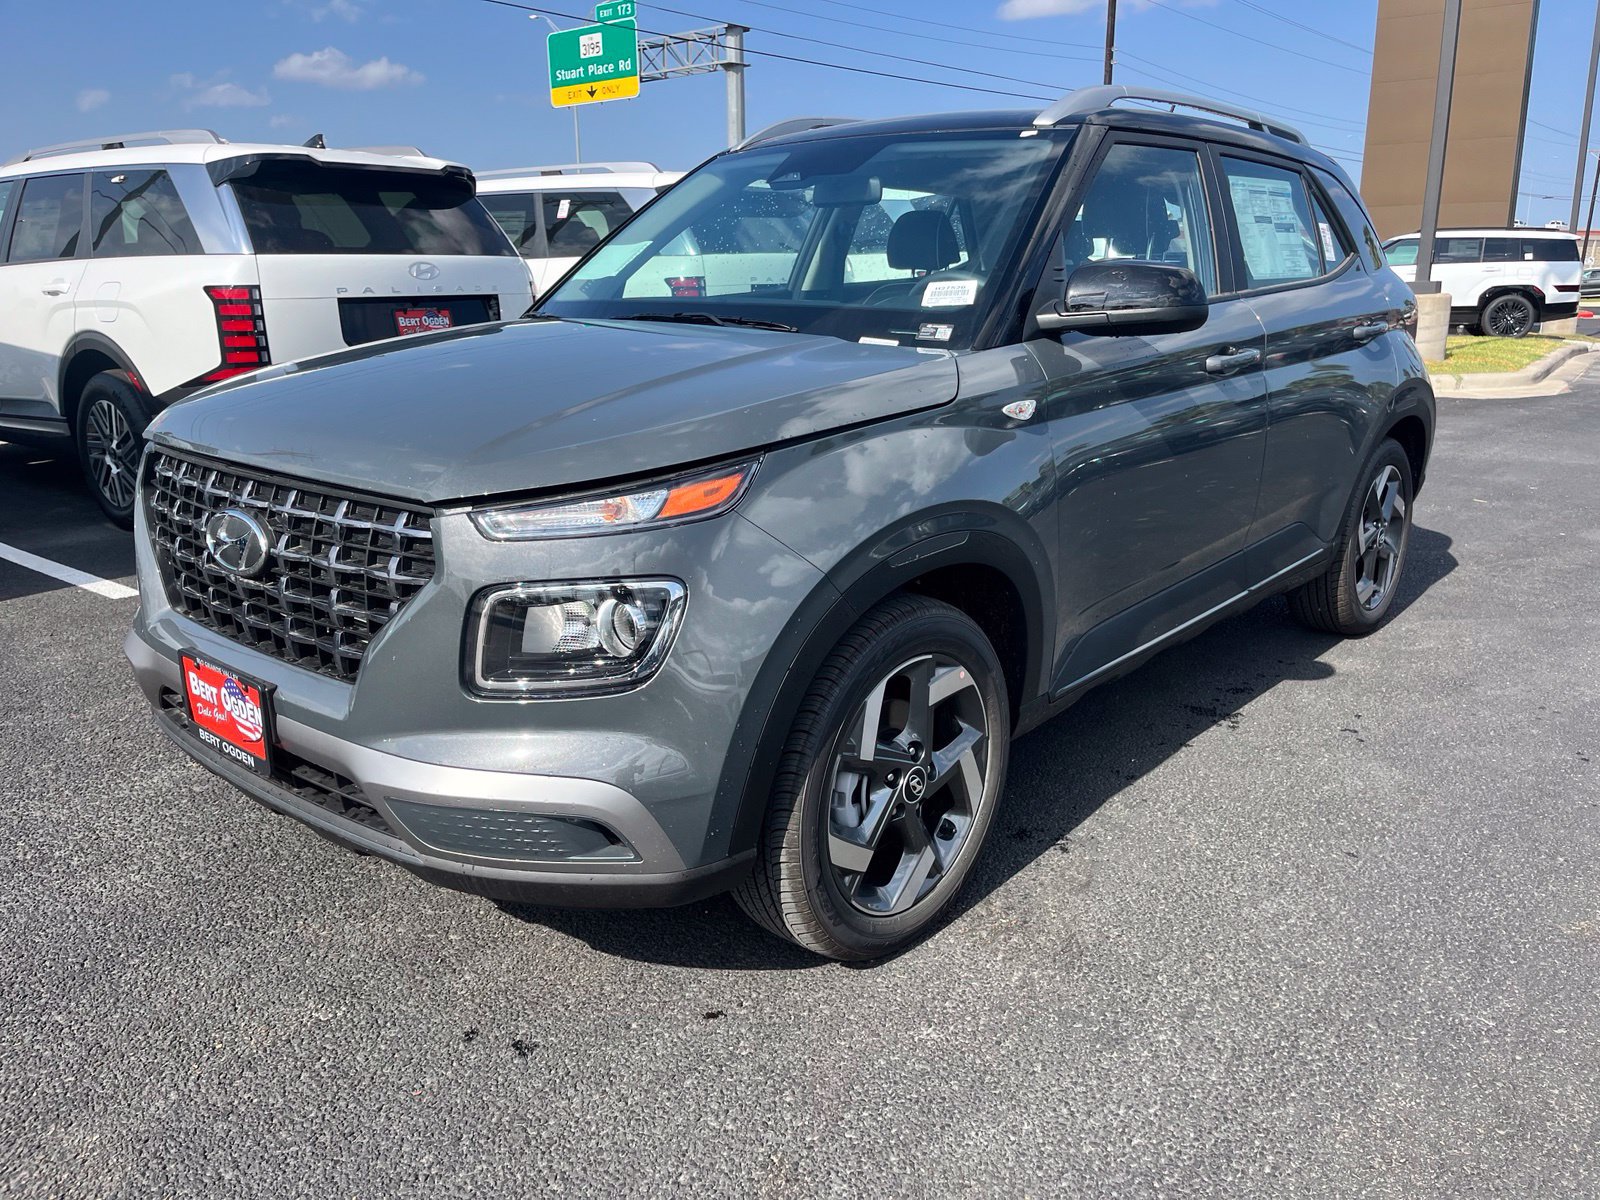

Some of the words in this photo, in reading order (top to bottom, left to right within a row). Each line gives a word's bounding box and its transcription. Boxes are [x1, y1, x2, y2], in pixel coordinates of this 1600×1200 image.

[600, 8, 613, 17] EXIT
[617, 3, 631, 16] 173
[582, 41, 601, 56] 3195
[556, 66, 584, 81] Stuart
[588, 62, 614, 76] Place
[618, 58, 631, 71] Rd
[568, 89, 582, 99] EXIT
[602, 84, 620, 95] ONLY
[337, 285, 498, 294] PALISADE
[398, 316, 420, 326] BERT
[421, 315, 449, 326] OGDEN
[188, 671, 218, 705] BERT
[220, 687, 263, 727] OGDEN
[199, 728, 221, 748] BERT
[222, 743, 255, 767] OGDEN
